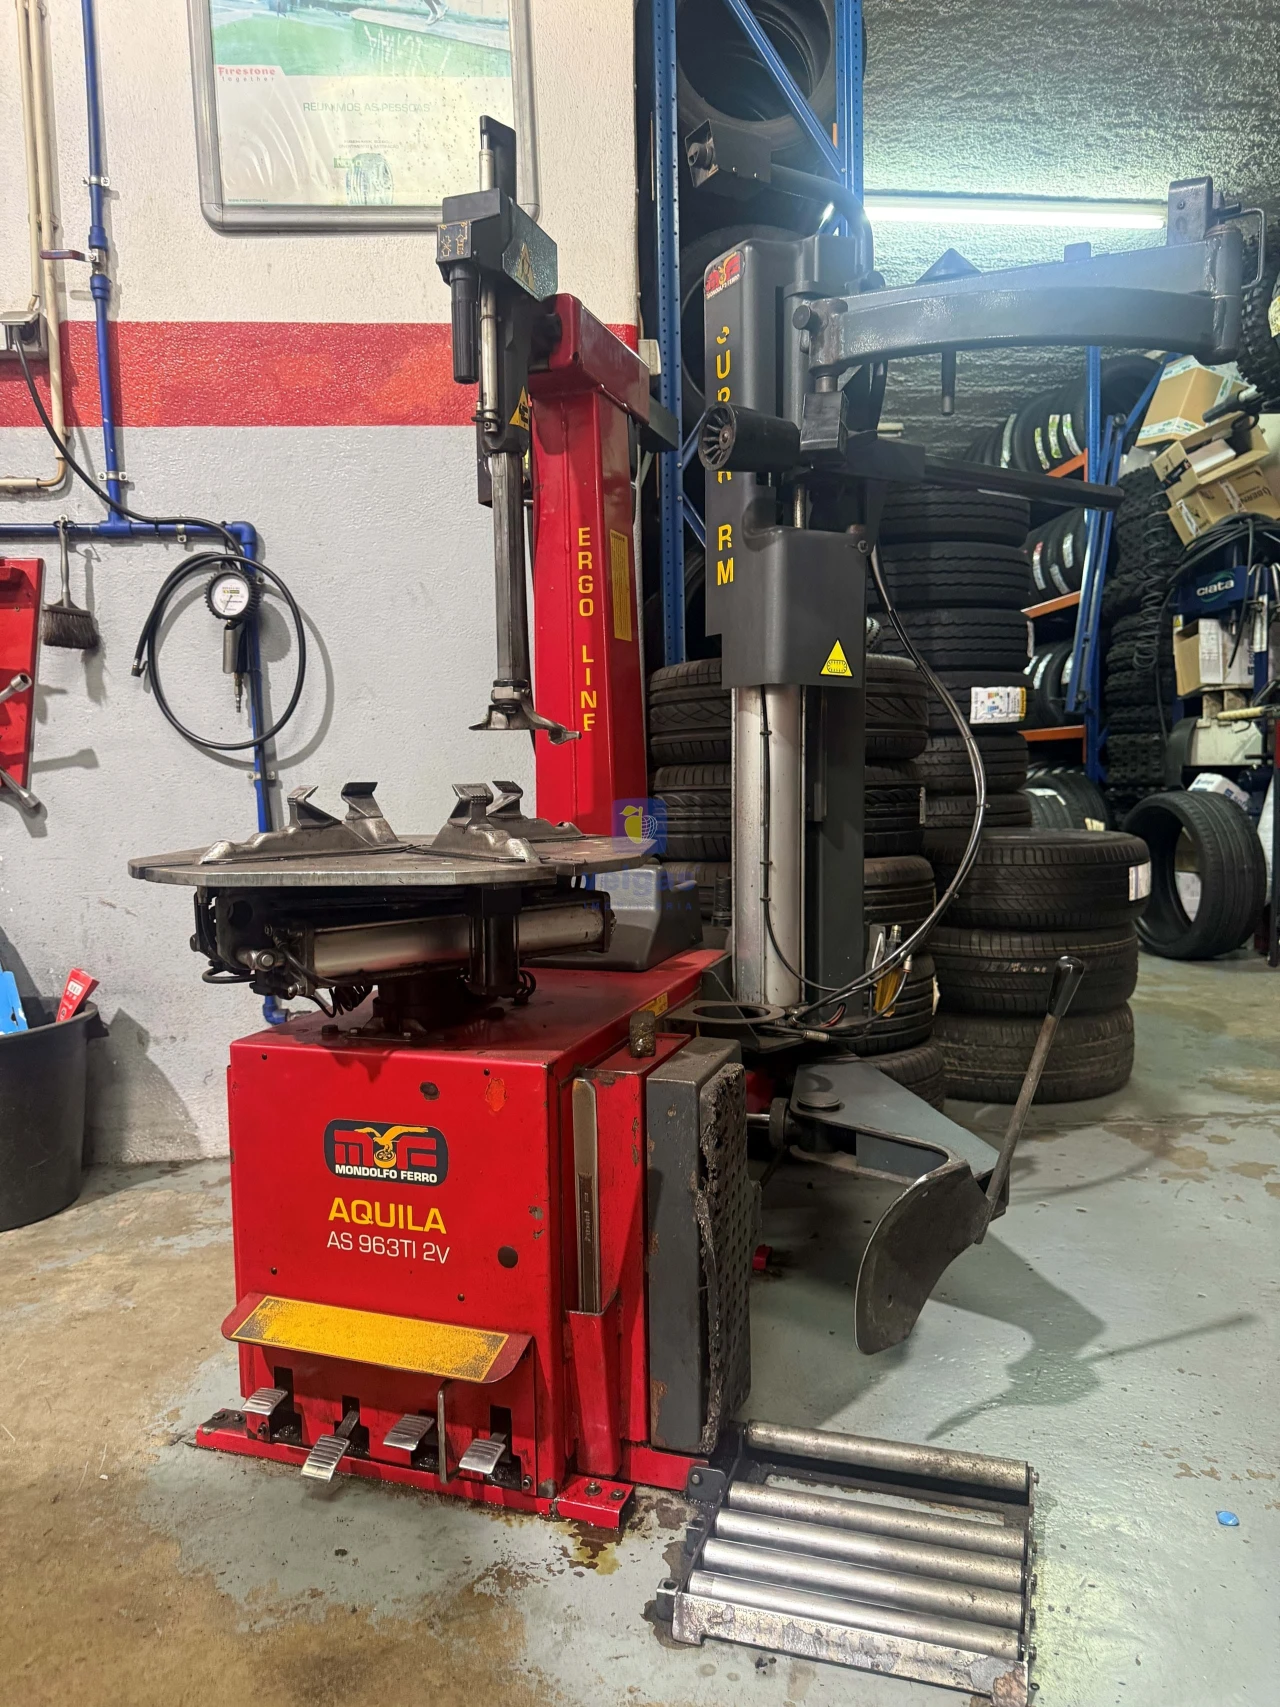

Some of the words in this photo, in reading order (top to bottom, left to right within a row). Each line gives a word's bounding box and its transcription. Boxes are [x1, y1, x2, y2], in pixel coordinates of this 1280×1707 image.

[218, 66, 276, 76] Firestone
[303, 102, 361, 112] REUNIMOS
[364, 103, 378, 112] AS
[381, 103, 431, 113] PESSOAS
[578, 527, 594, 617] ERGO
[335, 1164, 397, 1179] MONDOLFO
[400, 1170, 438, 1183] FERRO
[328, 1197, 447, 1235] AQUILA
[326, 1230, 353, 1251] AS
[358, 1234, 416, 1259] 963TI
[422, 1242, 451, 1264] 2V
